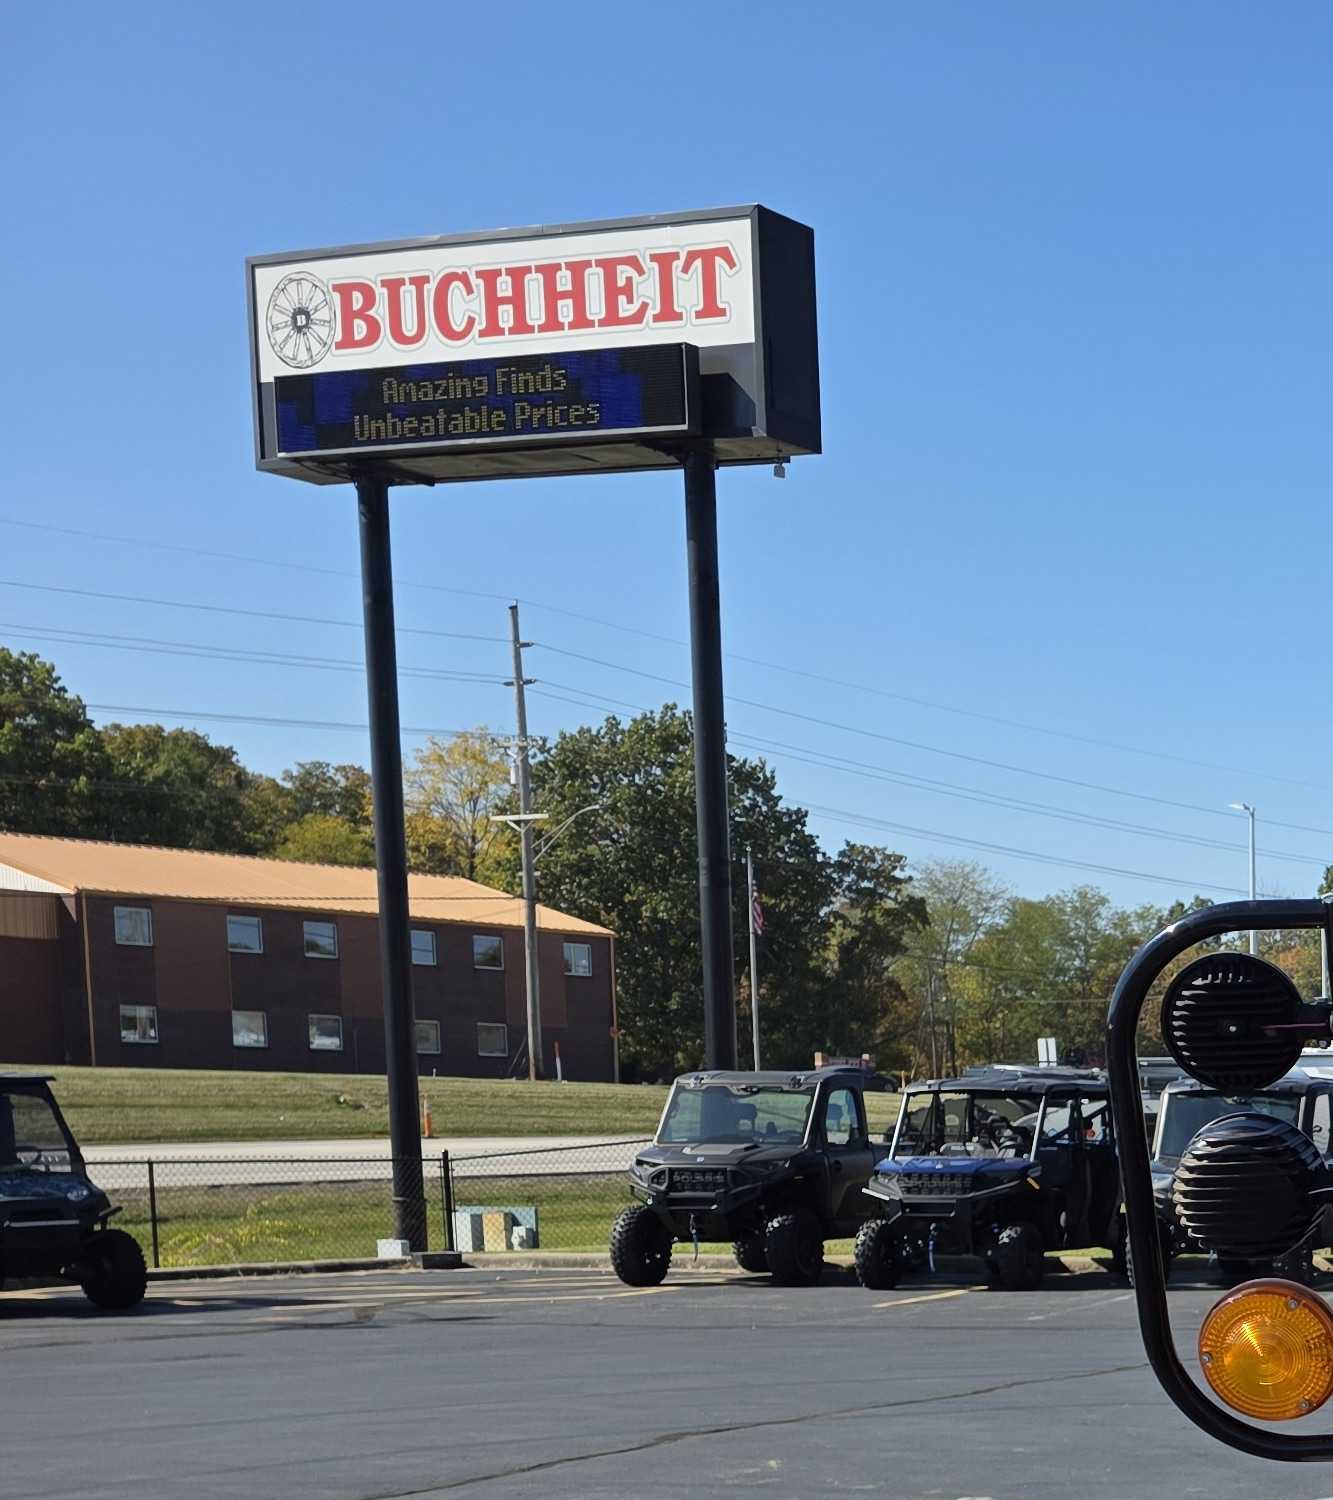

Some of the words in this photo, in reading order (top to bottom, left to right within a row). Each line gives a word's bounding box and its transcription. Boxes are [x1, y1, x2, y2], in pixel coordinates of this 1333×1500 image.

[331, 246, 737, 350] BUCHHEIT
[383, 373, 488, 404] Amazing
[495, 364, 567, 396] Finds
[353, 405, 507, 441] Unbeatable
[514, 401, 601, 430] Prices
